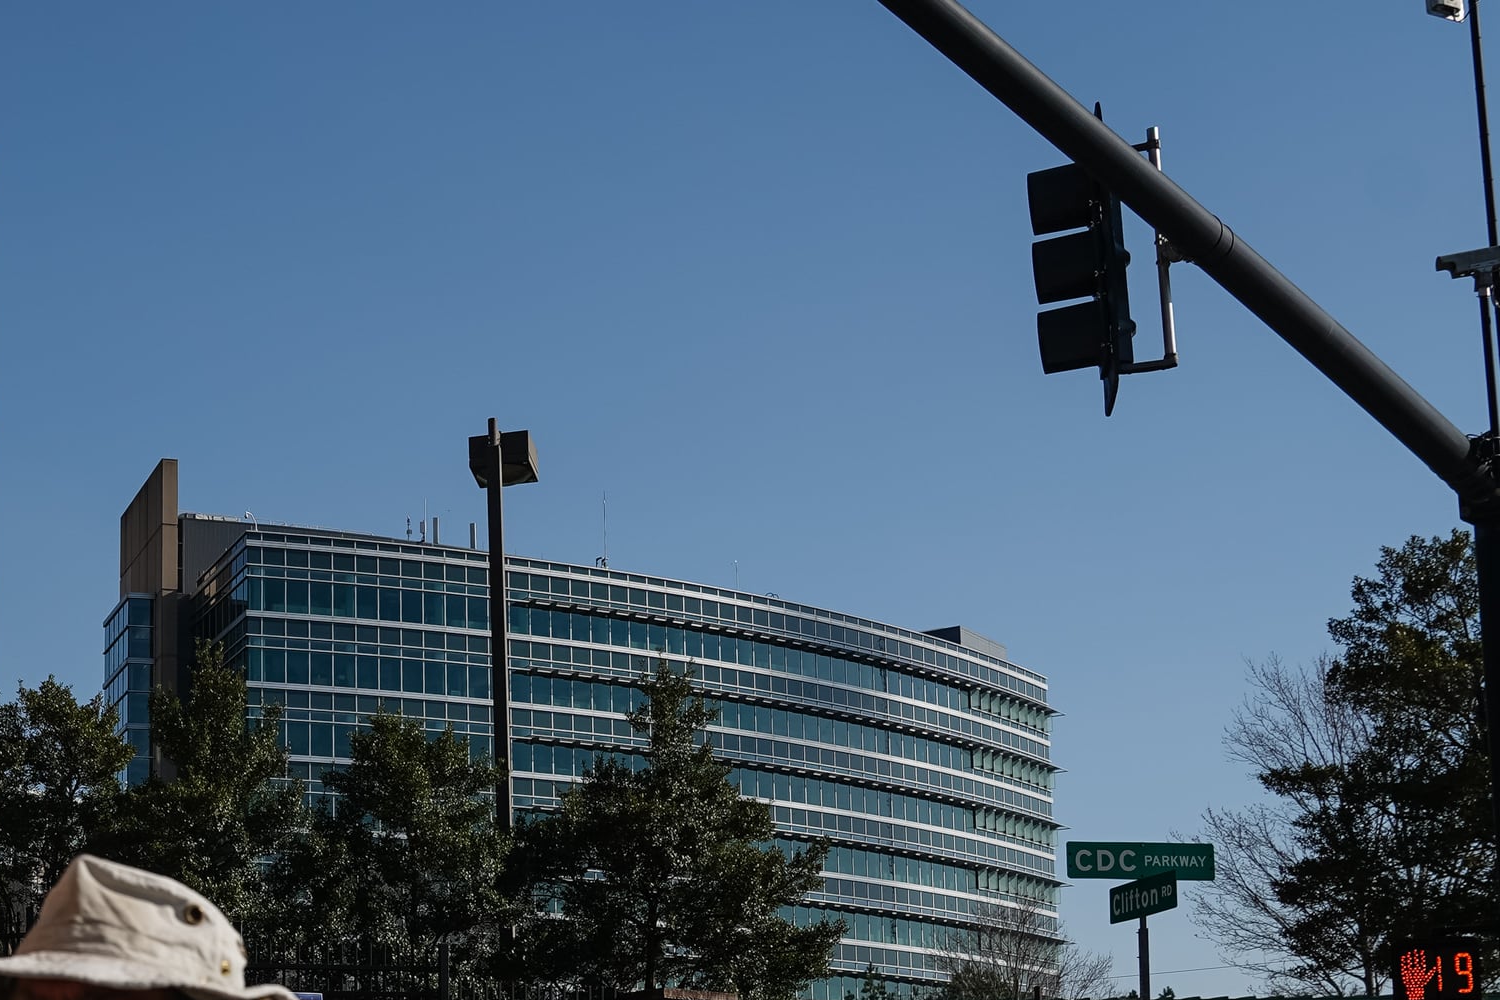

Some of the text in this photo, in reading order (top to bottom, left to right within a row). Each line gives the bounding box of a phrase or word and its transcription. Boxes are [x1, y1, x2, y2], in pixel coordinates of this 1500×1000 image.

[1075, 849, 1206, 872] CDC PARKWAY
[1113, 885, 1172, 916] Clifton RD
[1436, 952, 1473, 993] 19
